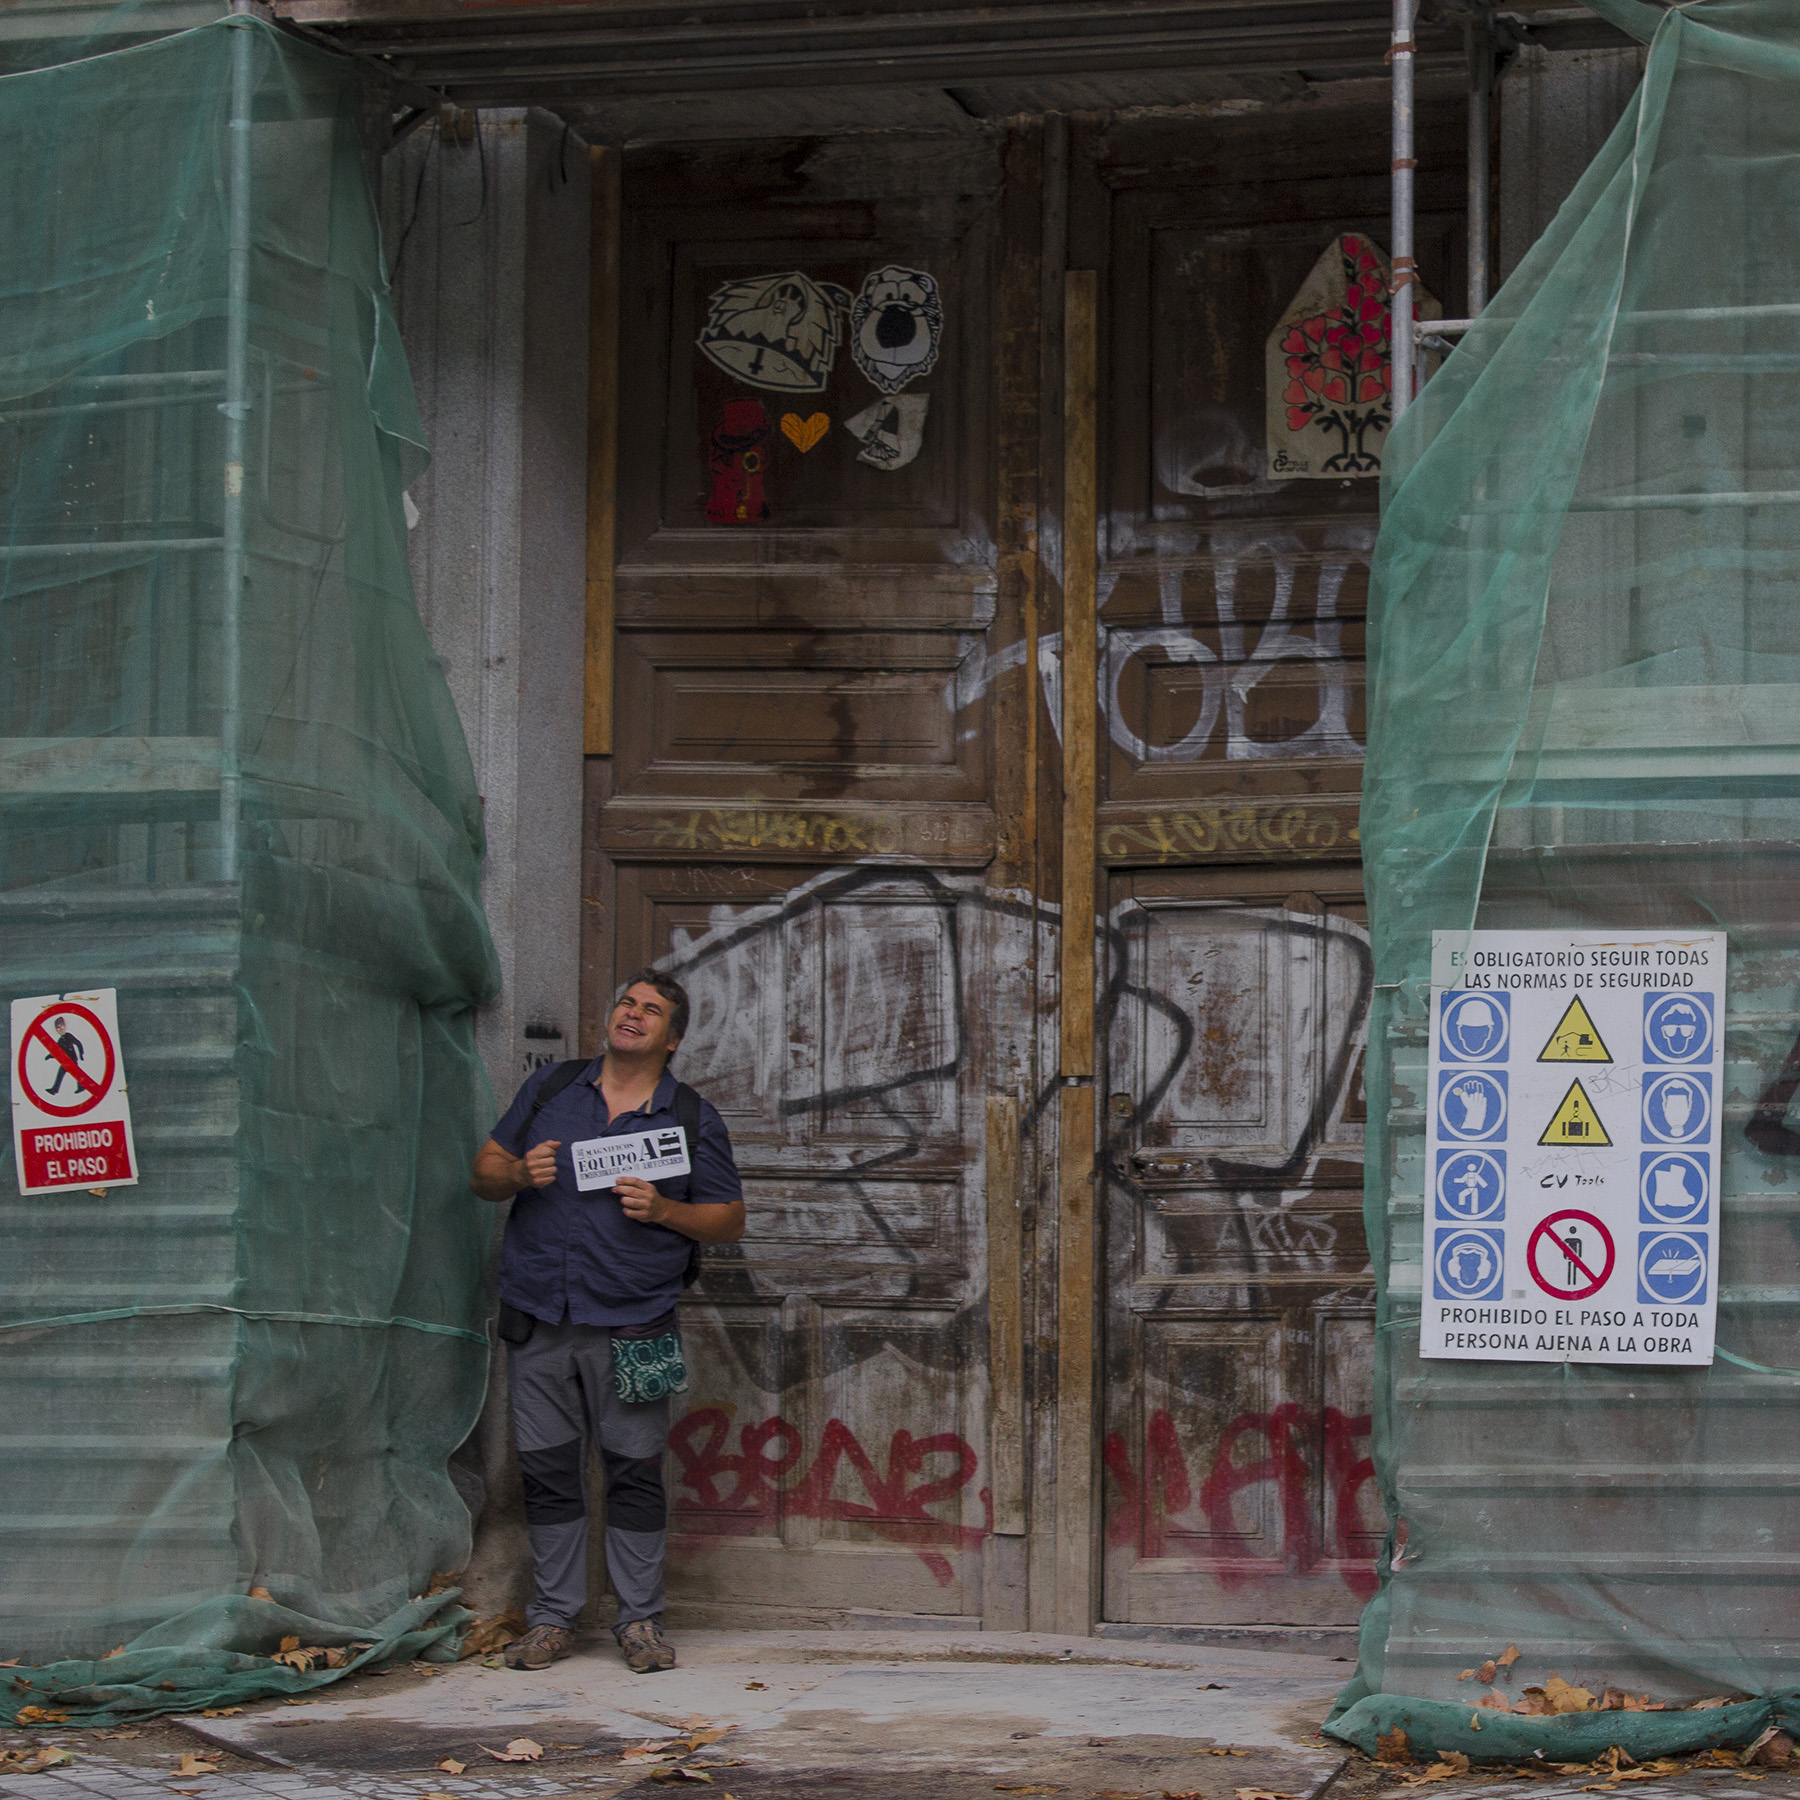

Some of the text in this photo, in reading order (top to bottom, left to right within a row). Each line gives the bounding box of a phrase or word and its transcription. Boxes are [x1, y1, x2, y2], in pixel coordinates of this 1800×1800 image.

[1473, 951, 1585, 967] OBLIGATORIO
[1591, 951, 1650, 967] SEGUIR
[1656, 950, 1709, 966] TODAS
[1464, 972, 1694, 989] LAS NORMAS DE SEGURIDAD
[34, 1128, 113, 1153] PROHIBIDO
[578, 1151, 637, 1173] EQUIPO
[639, 1137, 659, 1162] A
[46, 1156, 108, 1179] EL PASO
[1540, 1174, 1605, 1188] CV Tools
[1440, 1308, 1699, 1328] PROHIBIDO EL PASO A TODA
[1444, 1333, 1692, 1353] PERSONA AJENA A LA OBRA
